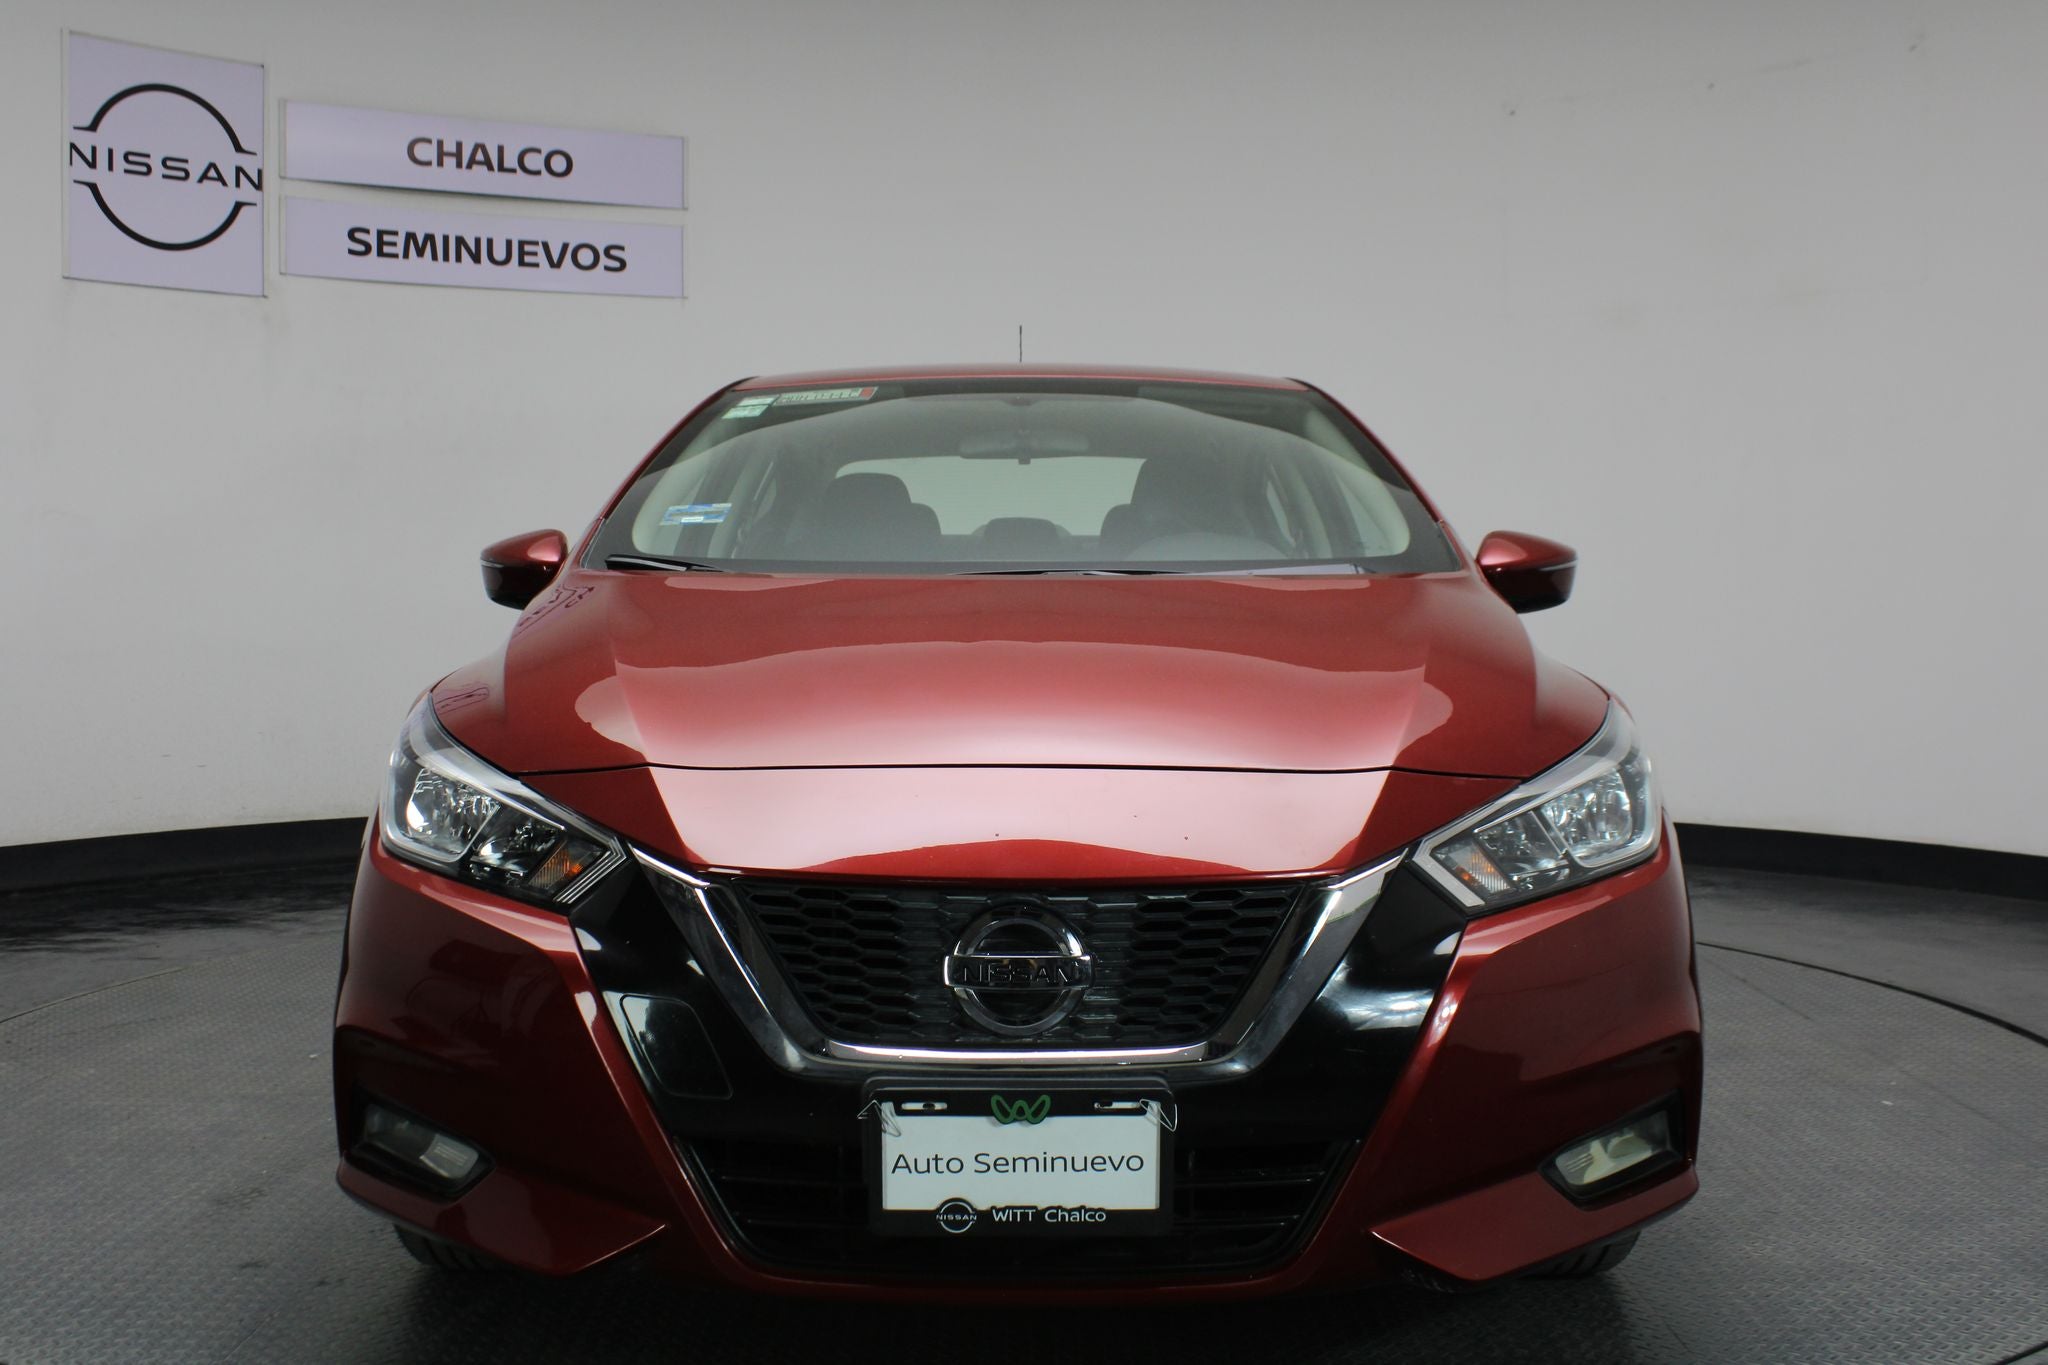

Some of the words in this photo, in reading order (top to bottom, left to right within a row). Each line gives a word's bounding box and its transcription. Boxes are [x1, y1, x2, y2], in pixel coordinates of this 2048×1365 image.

[68, 142, 264, 192] NISSAN
[406, 137, 574, 178] CHALCO
[347, 226, 627, 273] SEMINUEVOS
[963, 963, 1071, 984] NISSAN
[891, 1153, 965, 1174] Auto
[974, 1151, 1145, 1174] Seminuevo
[935, 1212, 977, 1222] NISSAN
[991, 1208, 1037, 1223] WITT
[1044, 1207, 1107, 1223] Chalco
